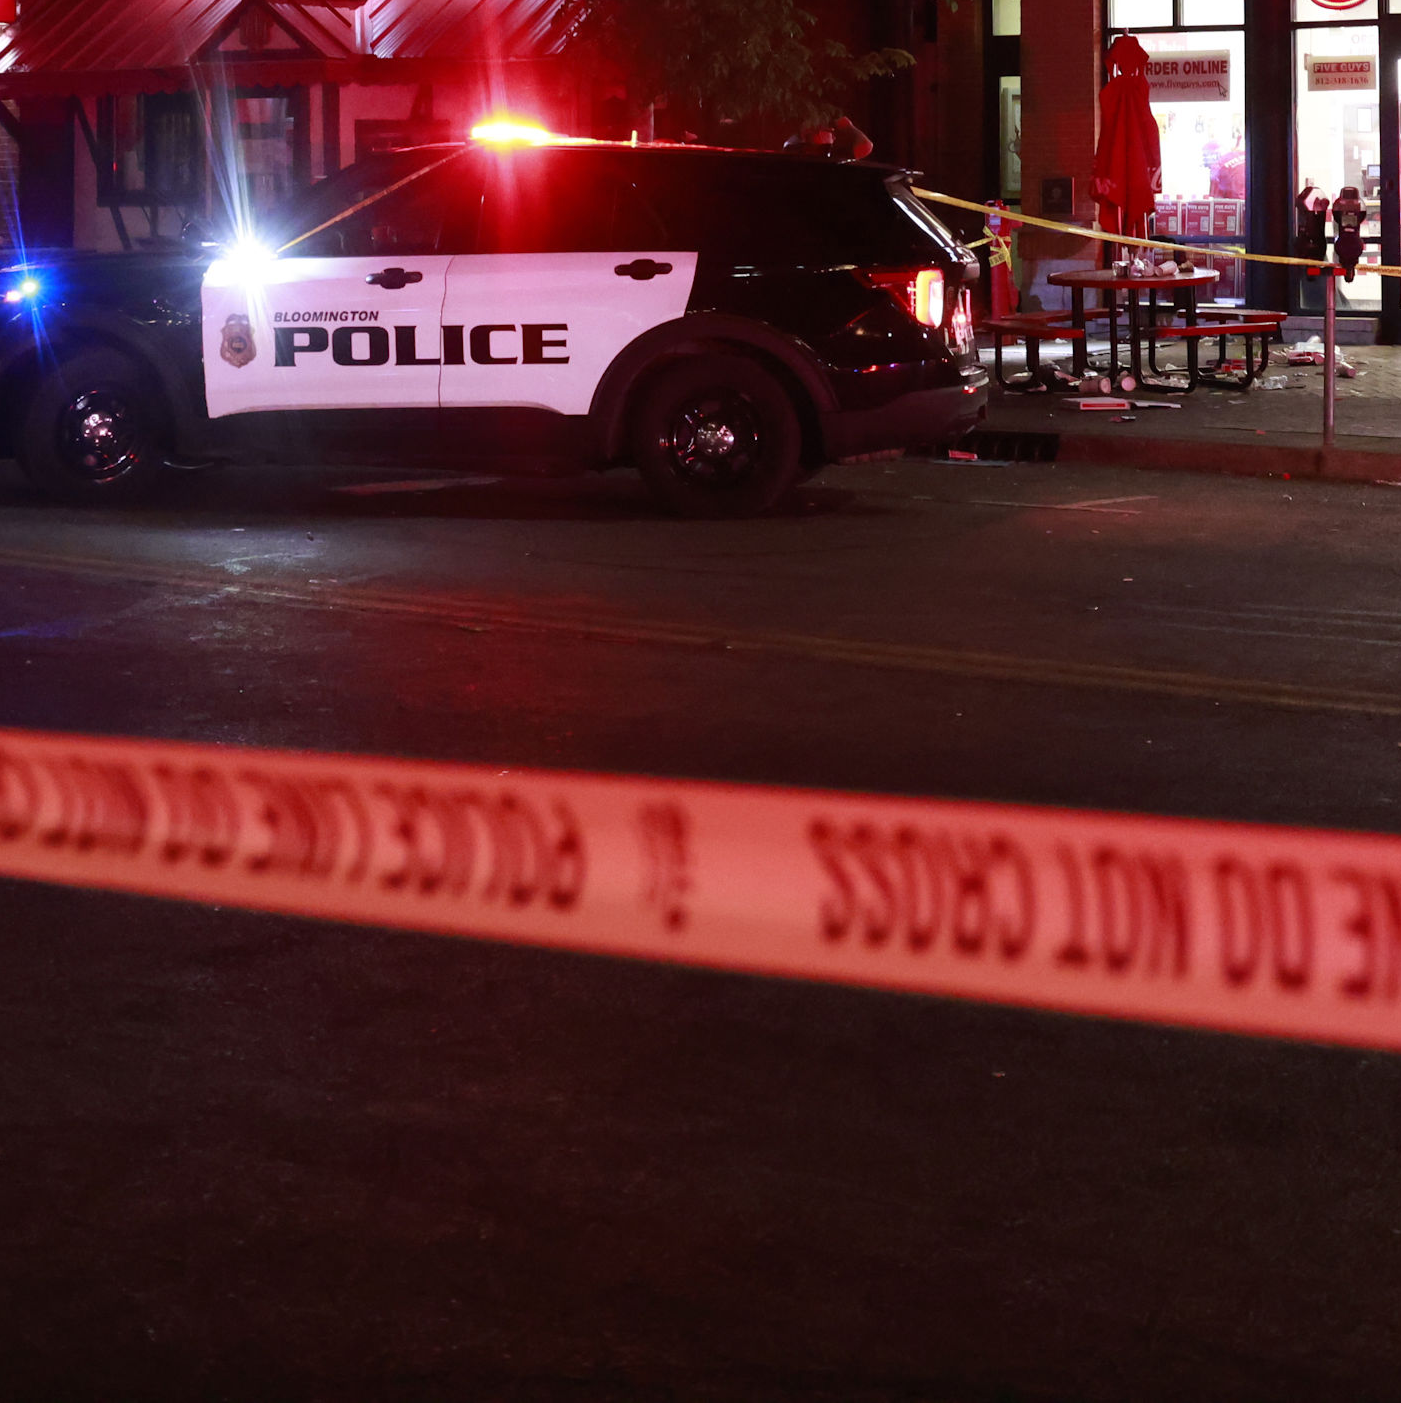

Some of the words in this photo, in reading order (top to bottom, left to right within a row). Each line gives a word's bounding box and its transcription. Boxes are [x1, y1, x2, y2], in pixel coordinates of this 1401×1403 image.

[1145, 61, 1179, 75] RDER
[1183, 60, 1228, 75] ONLINE
[1314, 63, 1337, 72] FIVE
[1340, 62, 1370, 72] GUYS
[274, 310, 379, 322] BLOOMINGTON
[274, 323, 570, 367] POLICE
[805, 815, 1038, 962] CROSS
[1055, 840, 1190, 979] NOT
[1213, 852, 1311, 991] DO
